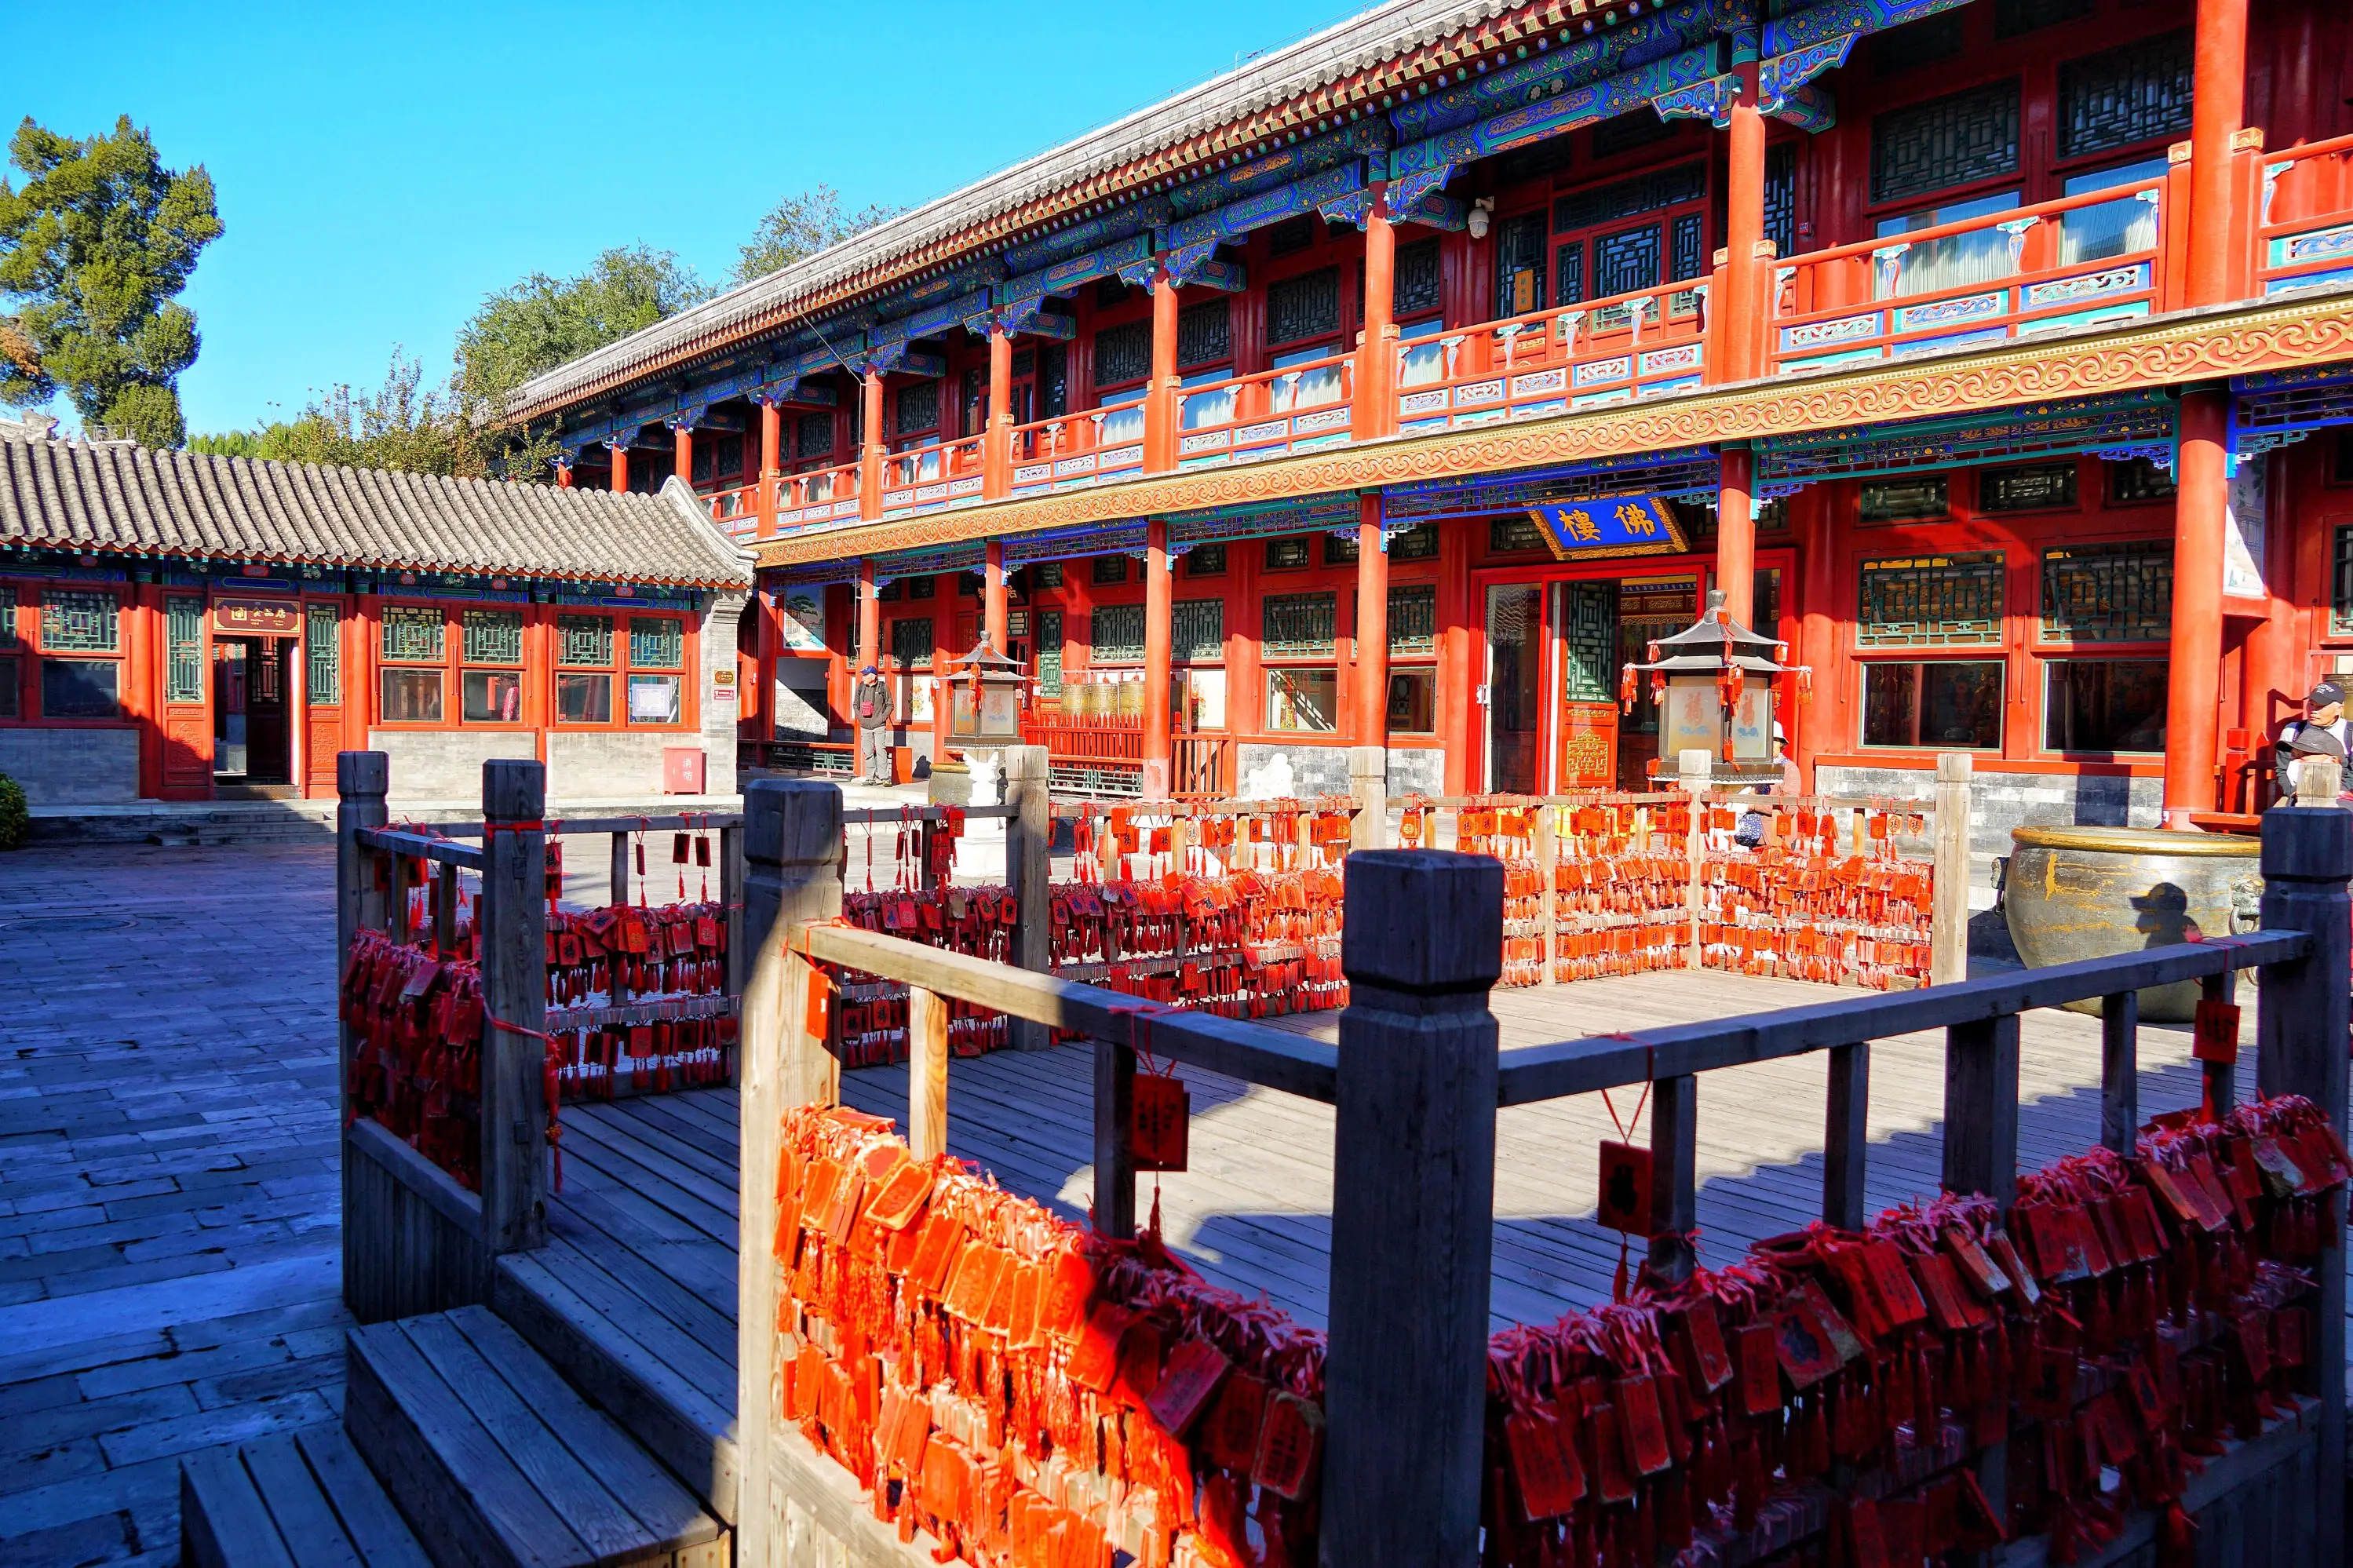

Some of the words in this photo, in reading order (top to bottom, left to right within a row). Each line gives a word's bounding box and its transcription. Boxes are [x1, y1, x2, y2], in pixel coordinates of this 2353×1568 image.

[253, 607, 286, 618] 食品店
[683, 757, 692, 782] 消防
[1463, 821, 1471, 832] 福
[1890, 818, 1898, 831] 福
[1912, 819, 1920, 831] 福
[1189, 828, 1197, 843] 福
